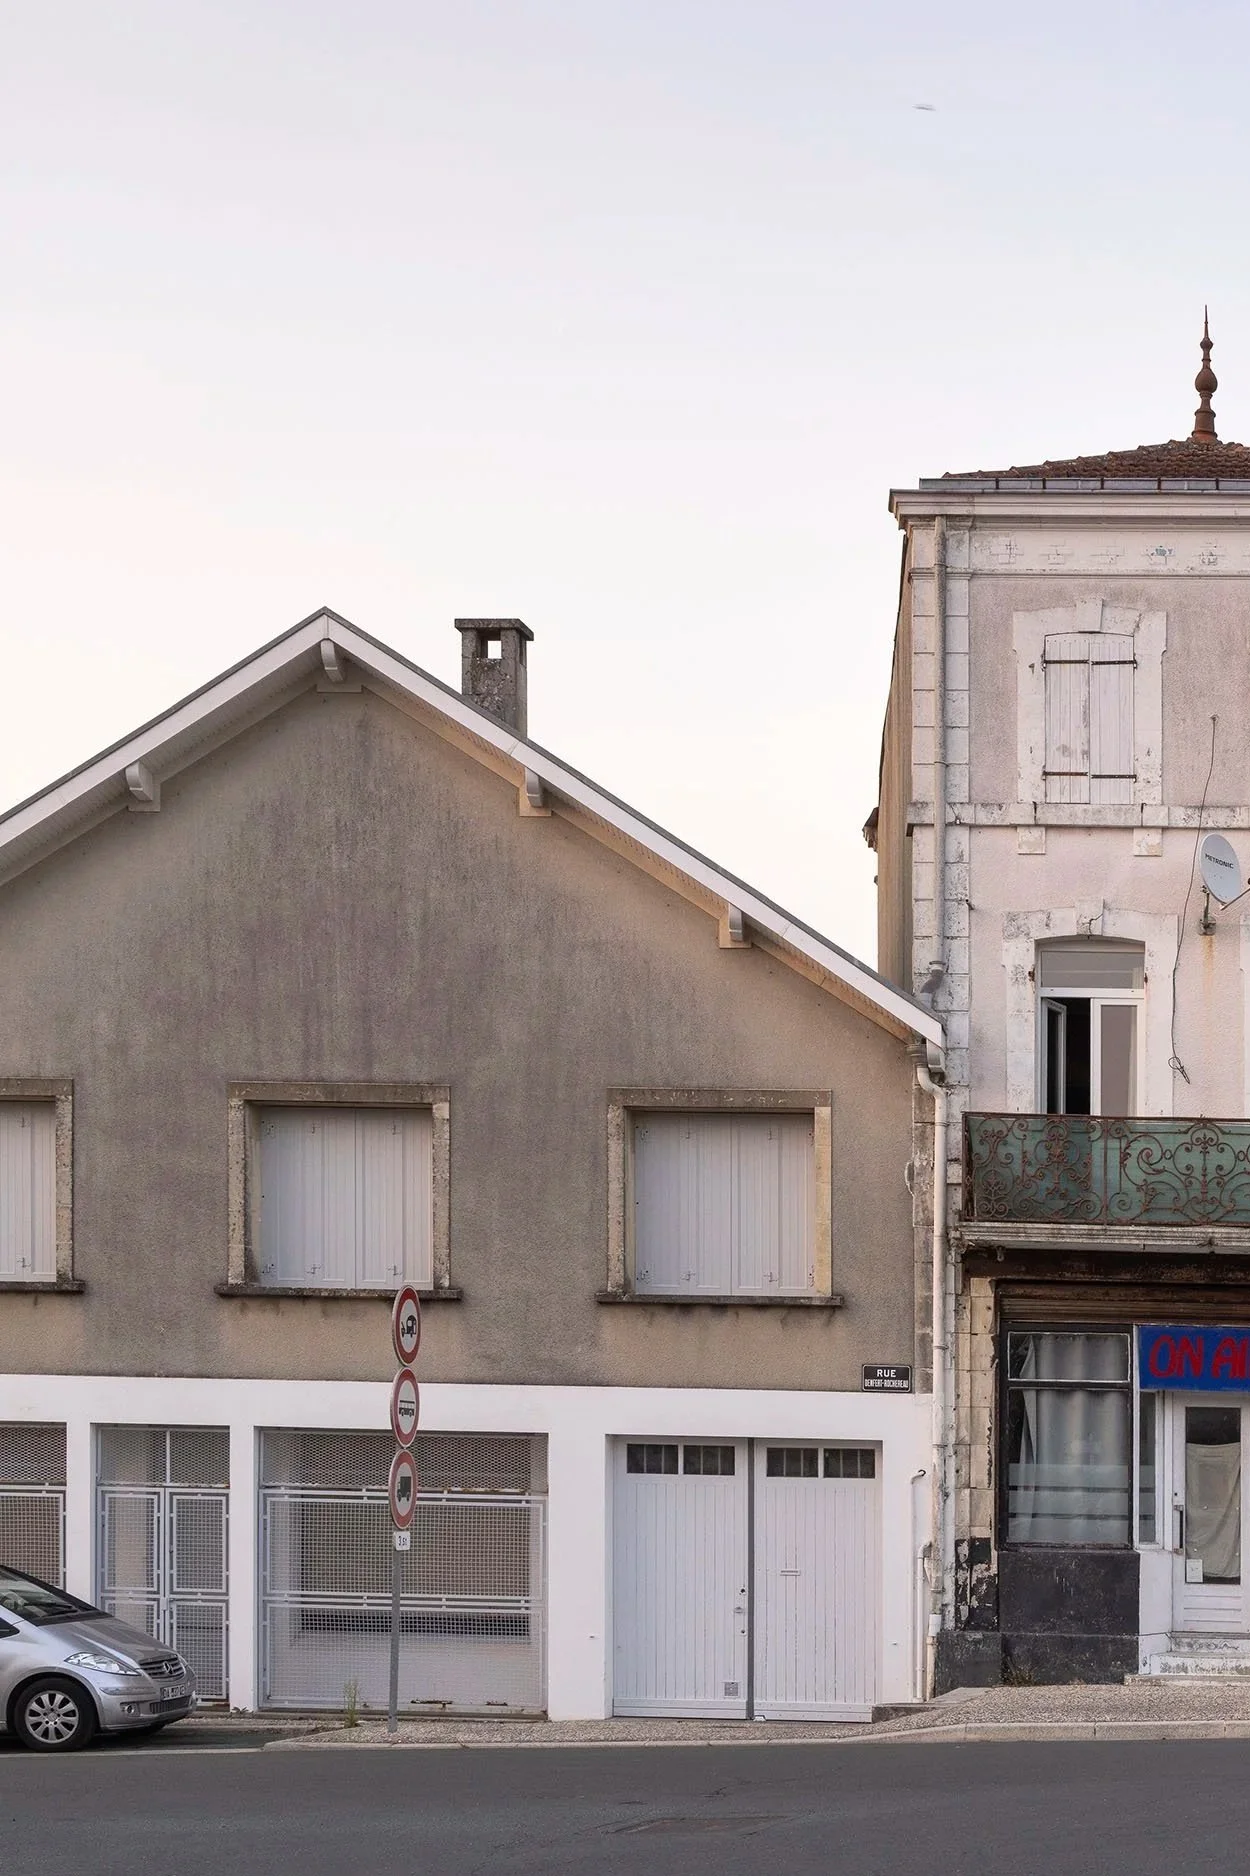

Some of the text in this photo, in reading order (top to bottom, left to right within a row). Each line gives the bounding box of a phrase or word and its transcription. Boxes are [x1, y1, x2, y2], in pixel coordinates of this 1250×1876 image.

[1205, 853, 1234, 869] METRONIC
[1149, 1334, 1204, 1378] ON
[877, 1369, 897, 1378] RUE
